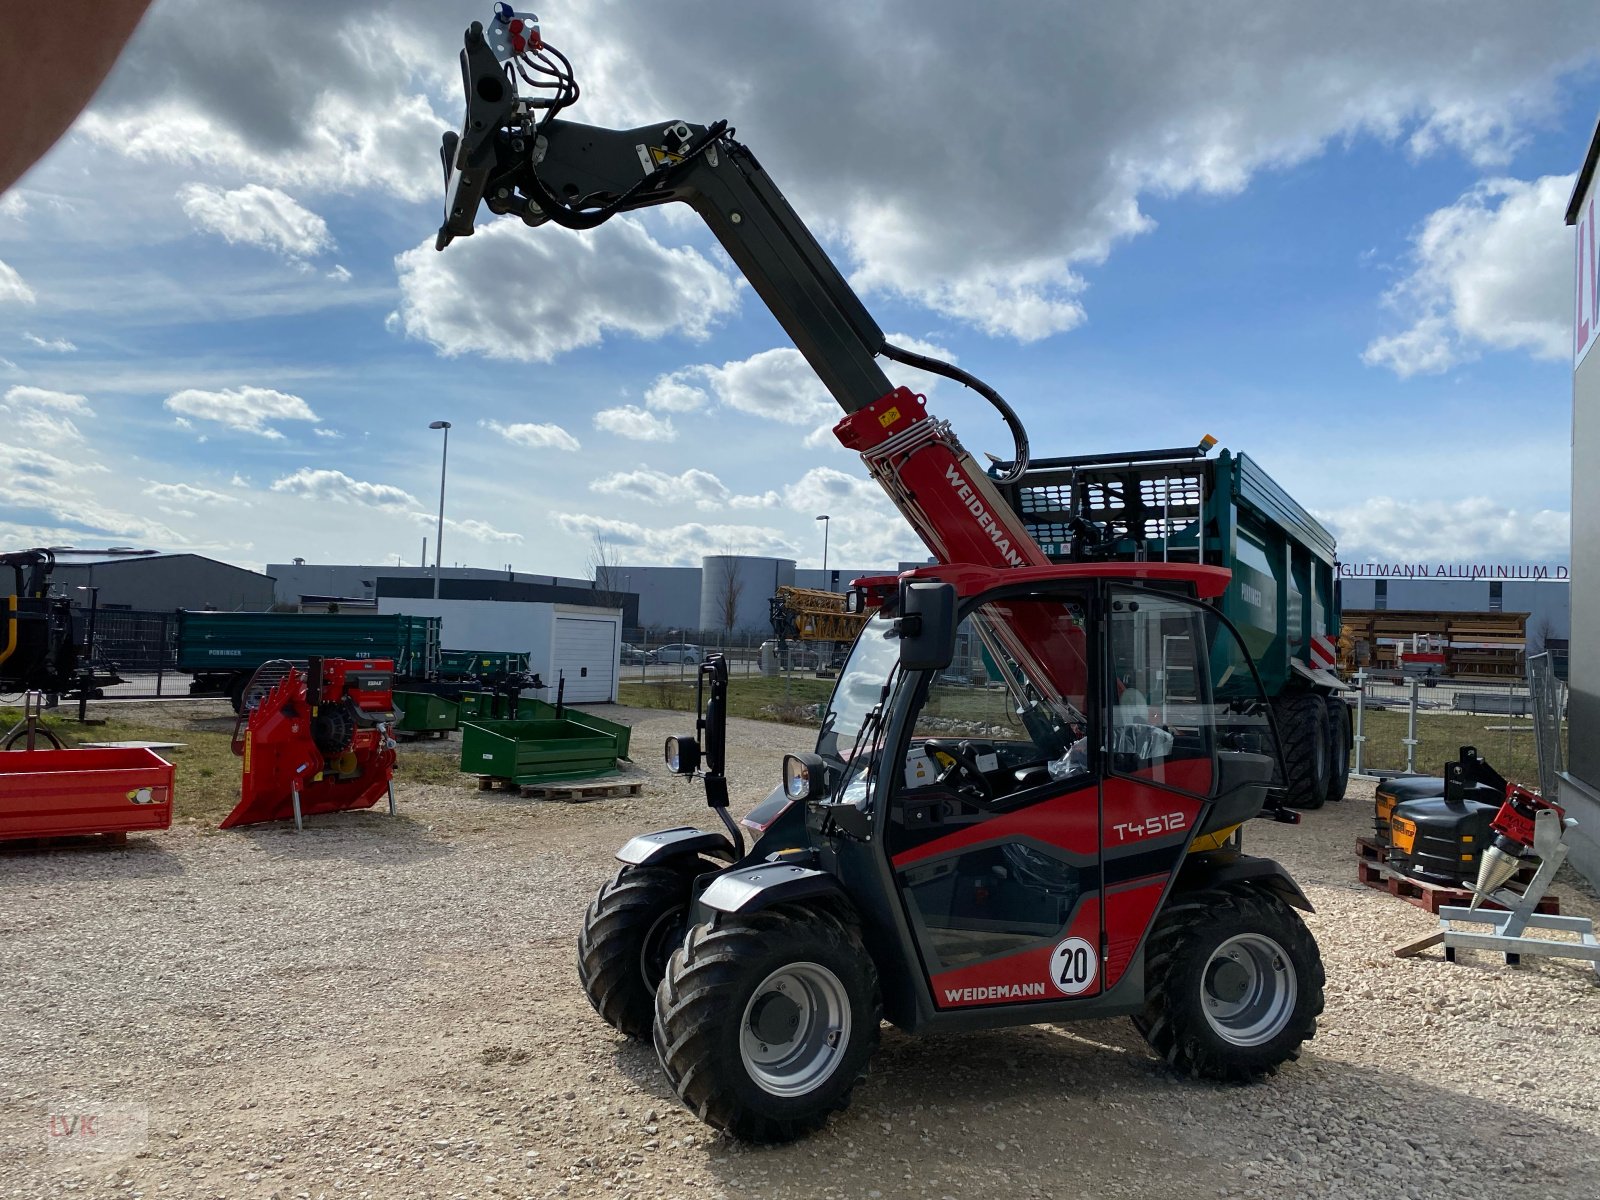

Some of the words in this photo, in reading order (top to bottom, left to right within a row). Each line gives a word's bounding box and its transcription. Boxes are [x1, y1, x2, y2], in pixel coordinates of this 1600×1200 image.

[946, 463, 1024, 568] WEIDEMAN
[1340, 563, 1429, 577] GUTMANN
[1435, 564, 1548, 579] ALUMINIUM
[1113, 812, 1185, 840] T4512
[1060, 948, 1087, 984] 20
[944, 983, 1045, 1002] WEIDEMANN
